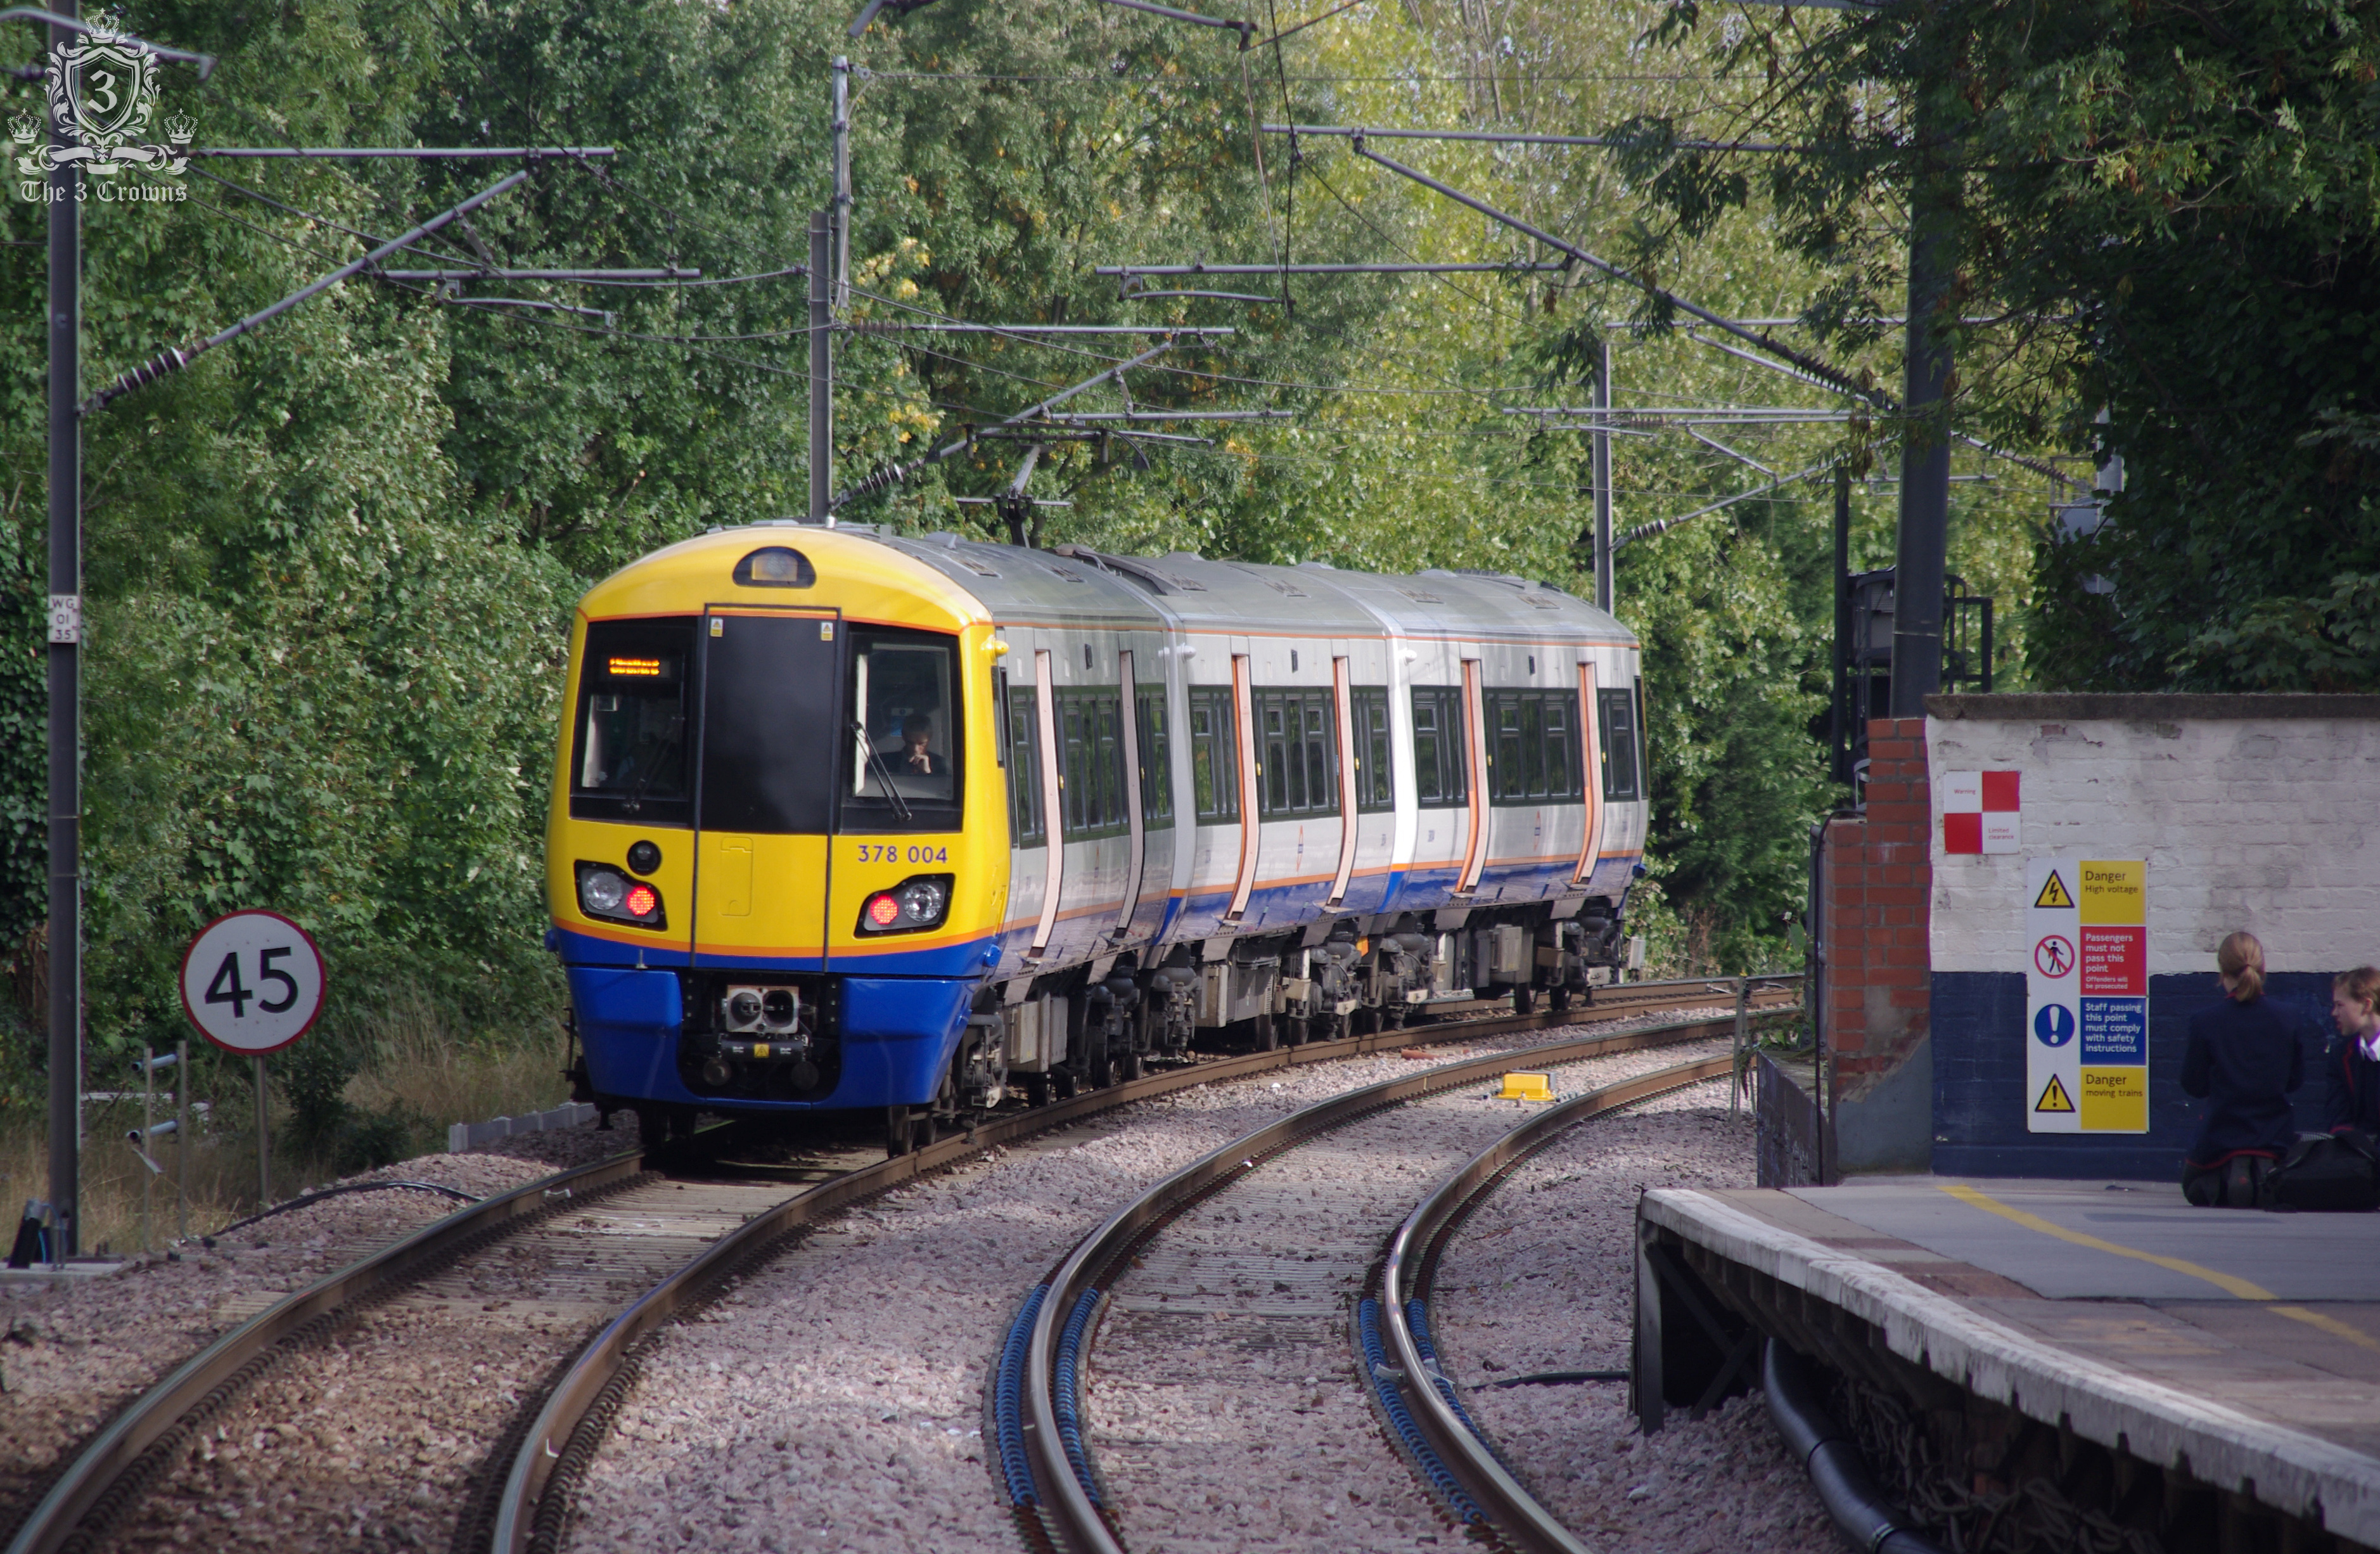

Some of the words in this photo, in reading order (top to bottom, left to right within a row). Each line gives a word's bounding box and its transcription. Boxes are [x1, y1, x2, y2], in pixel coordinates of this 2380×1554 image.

[55, 629, 71, 639] 35
[858, 845, 898, 863] 378
[908, 845, 948, 864] 004
[2085, 870, 2126, 883] Danger
[2085, 885, 2104, 894] High
[2107, 885, 2139, 895] voltage
[2085, 933, 2133, 944] Passengers
[2085, 955, 2105, 963] pass
[2085, 964, 2109, 974] point
[205, 946, 298, 1018] 45
[2085, 1003, 2108, 1011] Staff
[2110, 1004, 2142, 1013] passing
[2104, 1014, 2128, 1024] point
[2109, 1024, 2141, 1034] comply
[2085, 1034, 2105, 1042] with
[2108, 1034, 2135, 1044] safety
[2085, 1044, 2137, 1052] instructions
[2086, 1074, 2127, 1087] Danger
[2086, 1089, 2116, 1098] moving
